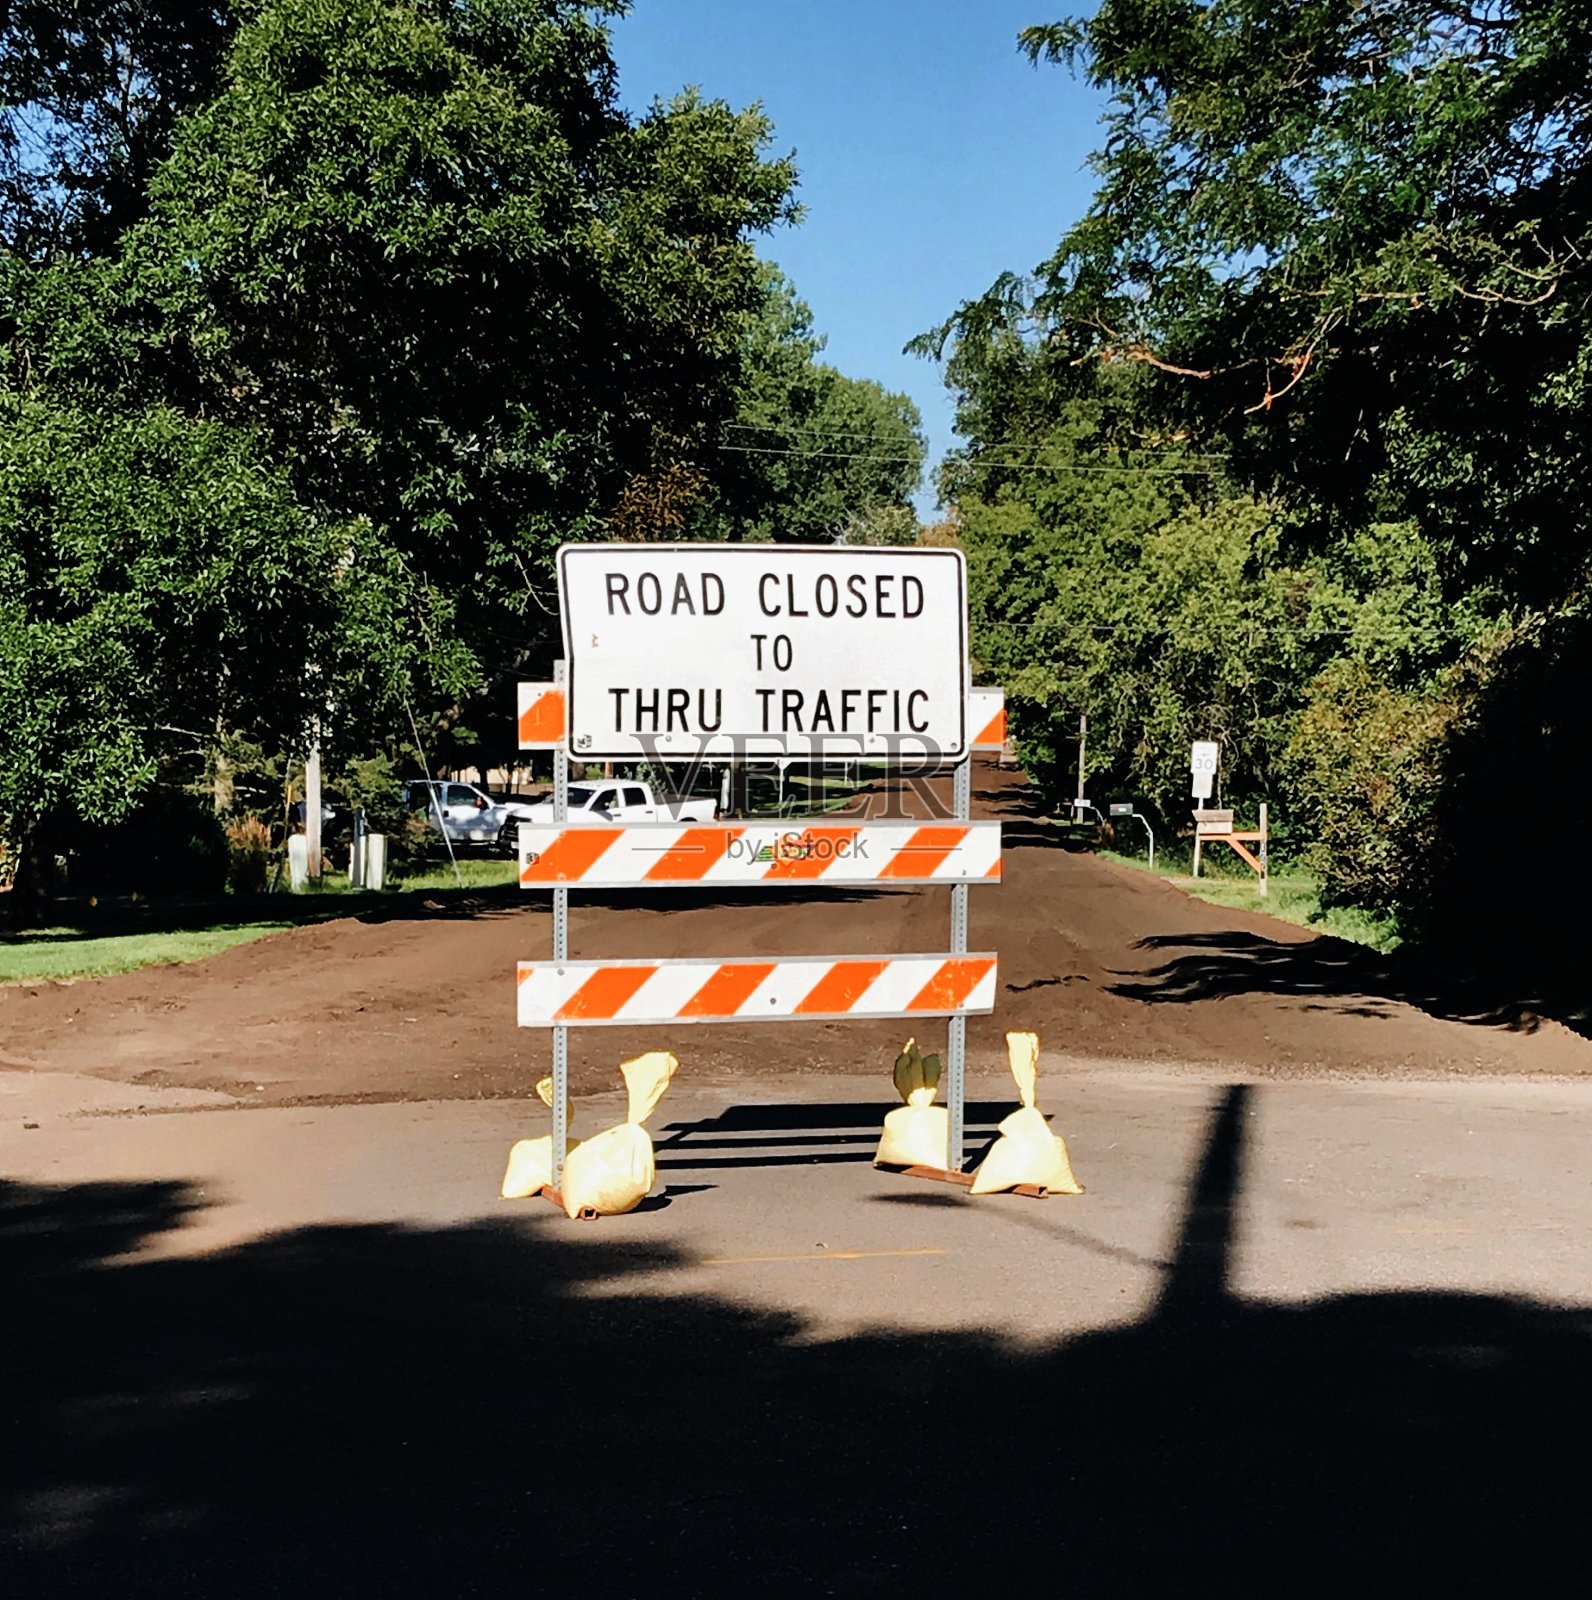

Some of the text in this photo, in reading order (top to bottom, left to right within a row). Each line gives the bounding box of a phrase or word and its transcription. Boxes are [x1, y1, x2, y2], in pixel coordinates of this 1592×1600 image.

[605, 572, 924, 618] ROAD CLOSED
[750, 634, 793, 672] TO
[608, 688, 929, 733] THRU TRAFFIC
[1195, 758, 1213, 770] 30
